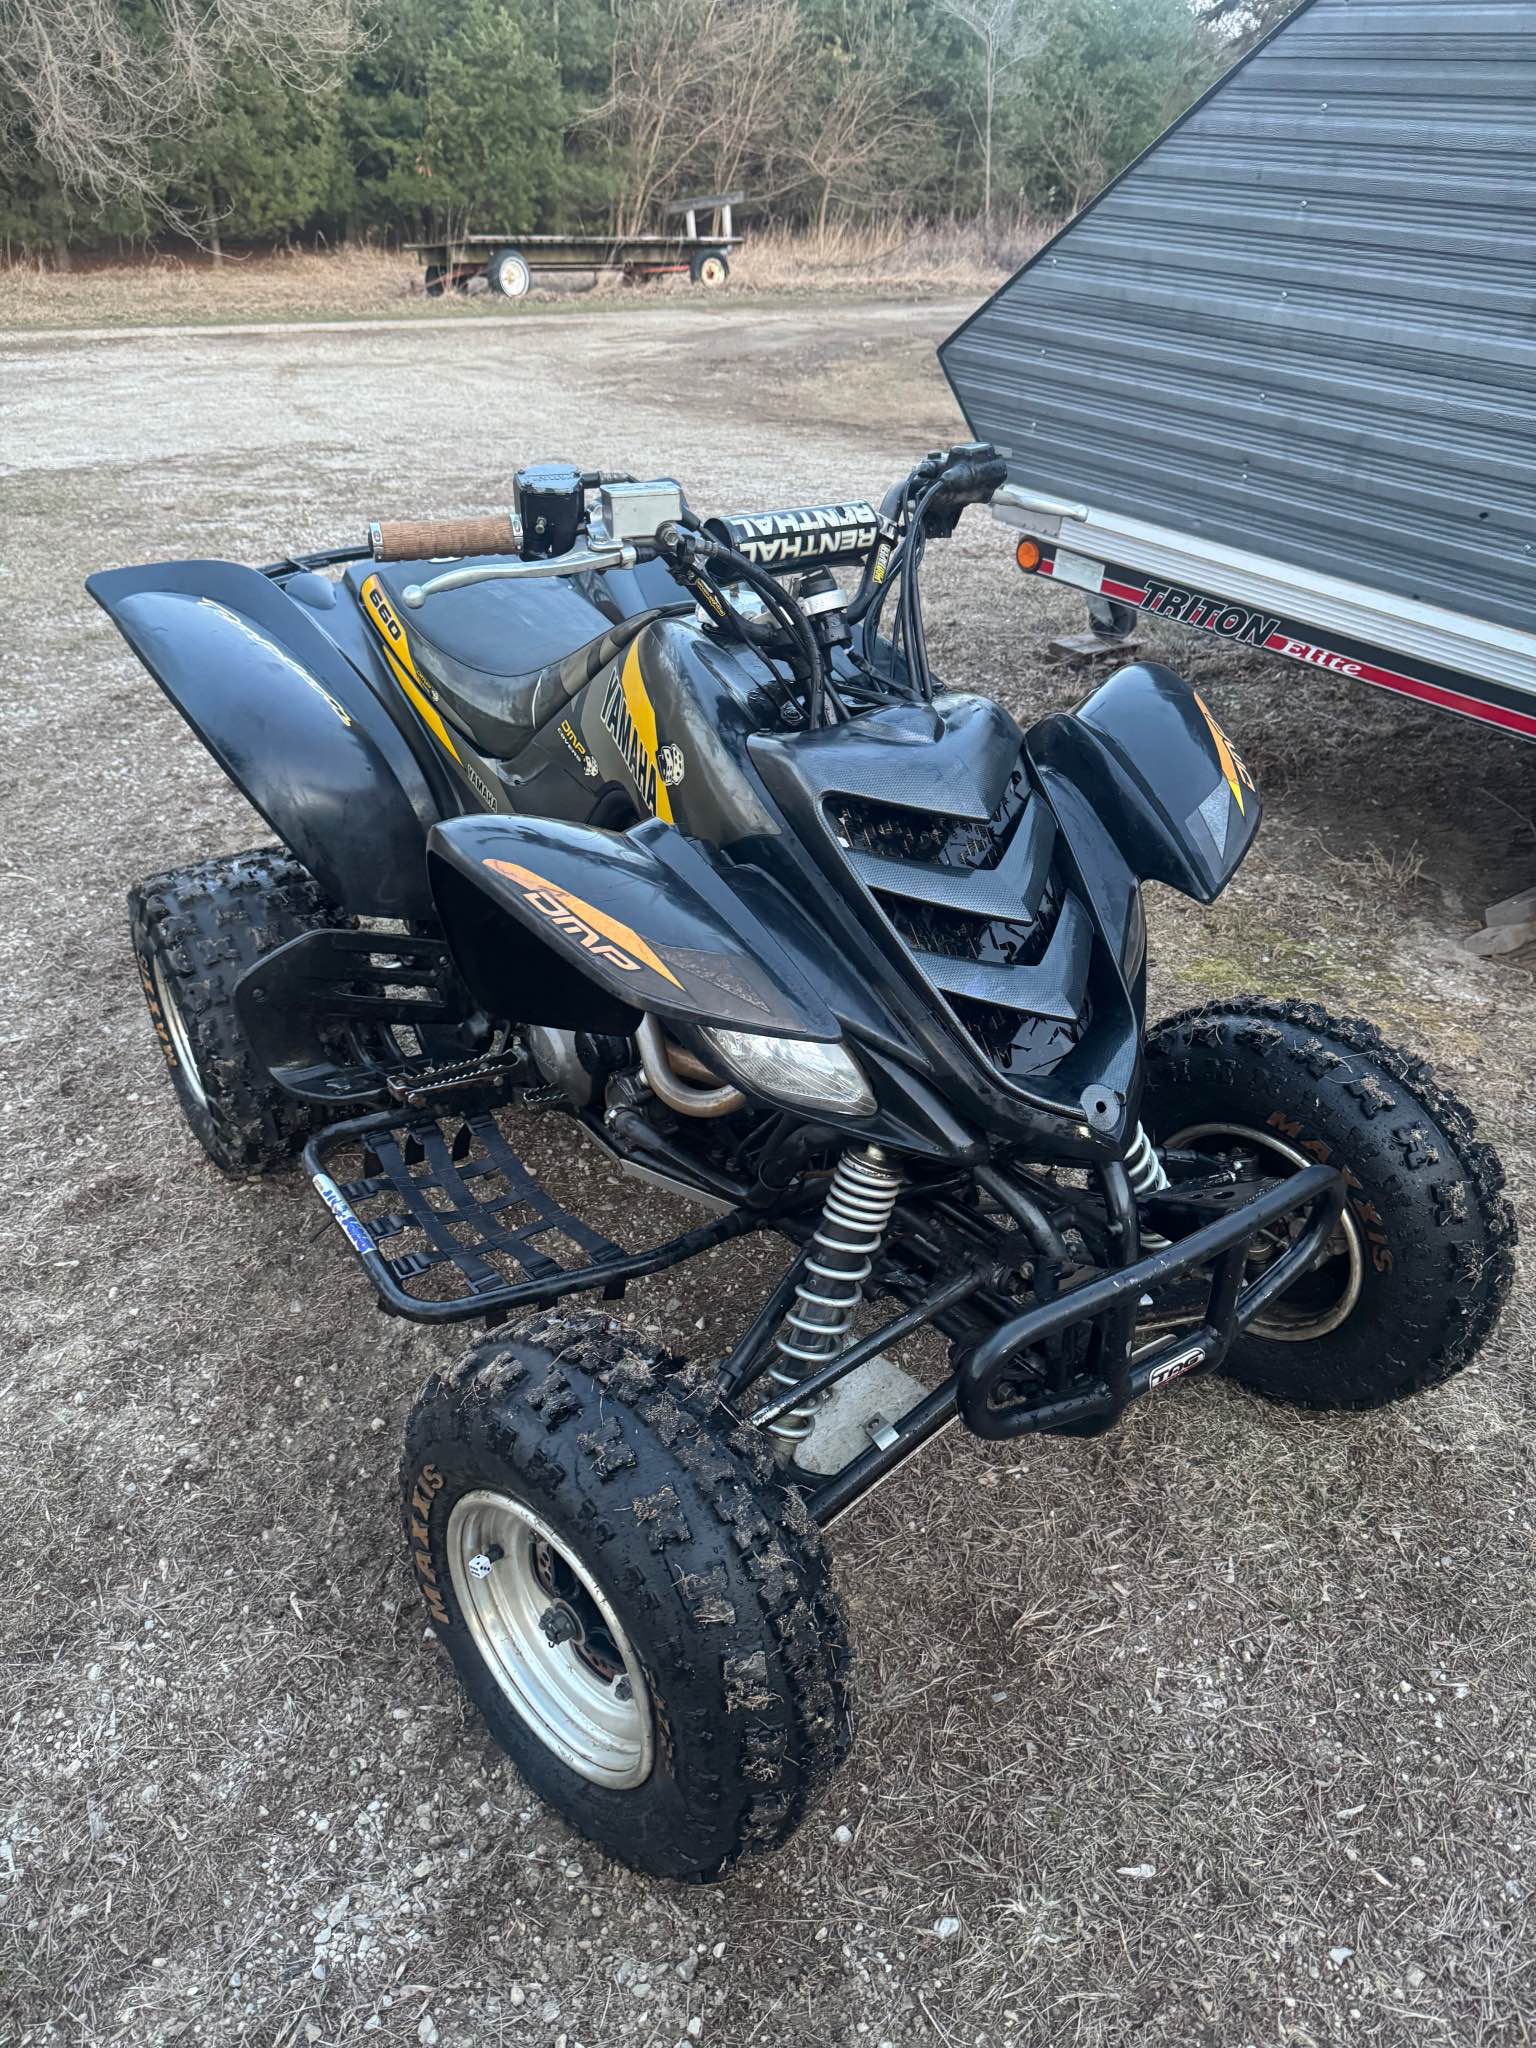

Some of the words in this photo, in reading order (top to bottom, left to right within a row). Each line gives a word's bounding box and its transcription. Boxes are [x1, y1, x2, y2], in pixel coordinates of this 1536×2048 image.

[739, 527, 878, 563] RENTHAL
[369, 588, 402, 642] 660
[1139, 580, 1281, 649] TRITON
[1282, 639, 1363, 677] Elite
[560, 719, 587, 755] DMP
[600, 666, 658, 818] YAMAHA
[467, 763, 498, 814] YAMAHA
[522, 889, 642, 971] DMP
[409, 1463, 450, 1625] MAXXIS
